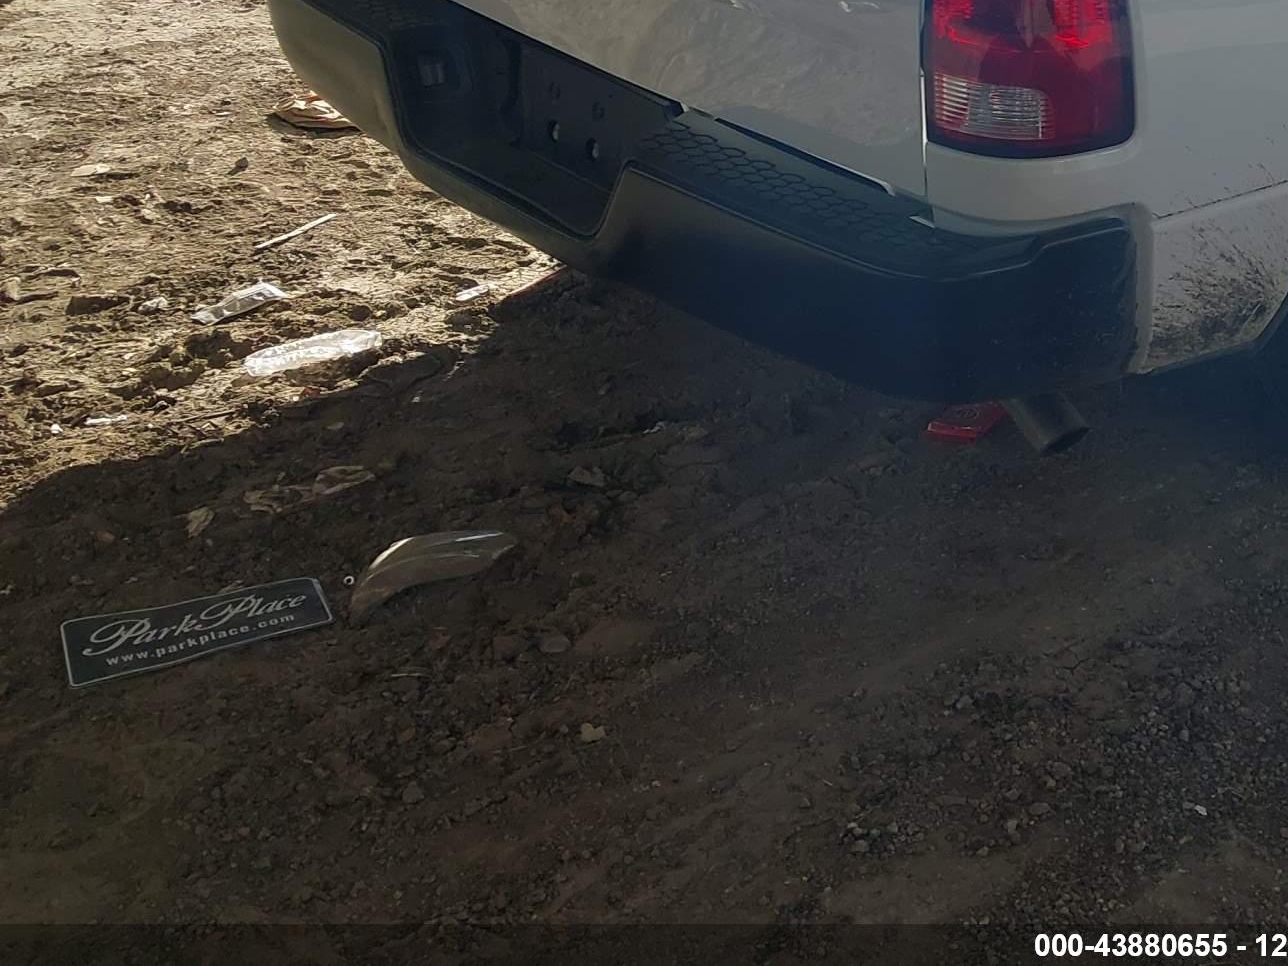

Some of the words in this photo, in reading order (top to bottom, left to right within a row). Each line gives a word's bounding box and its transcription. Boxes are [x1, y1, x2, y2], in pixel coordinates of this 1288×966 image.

[82, 614, 199, 656] Park
[193, 593, 307, 632] Place
[105, 613, 296, 667] www.parkplace.com
